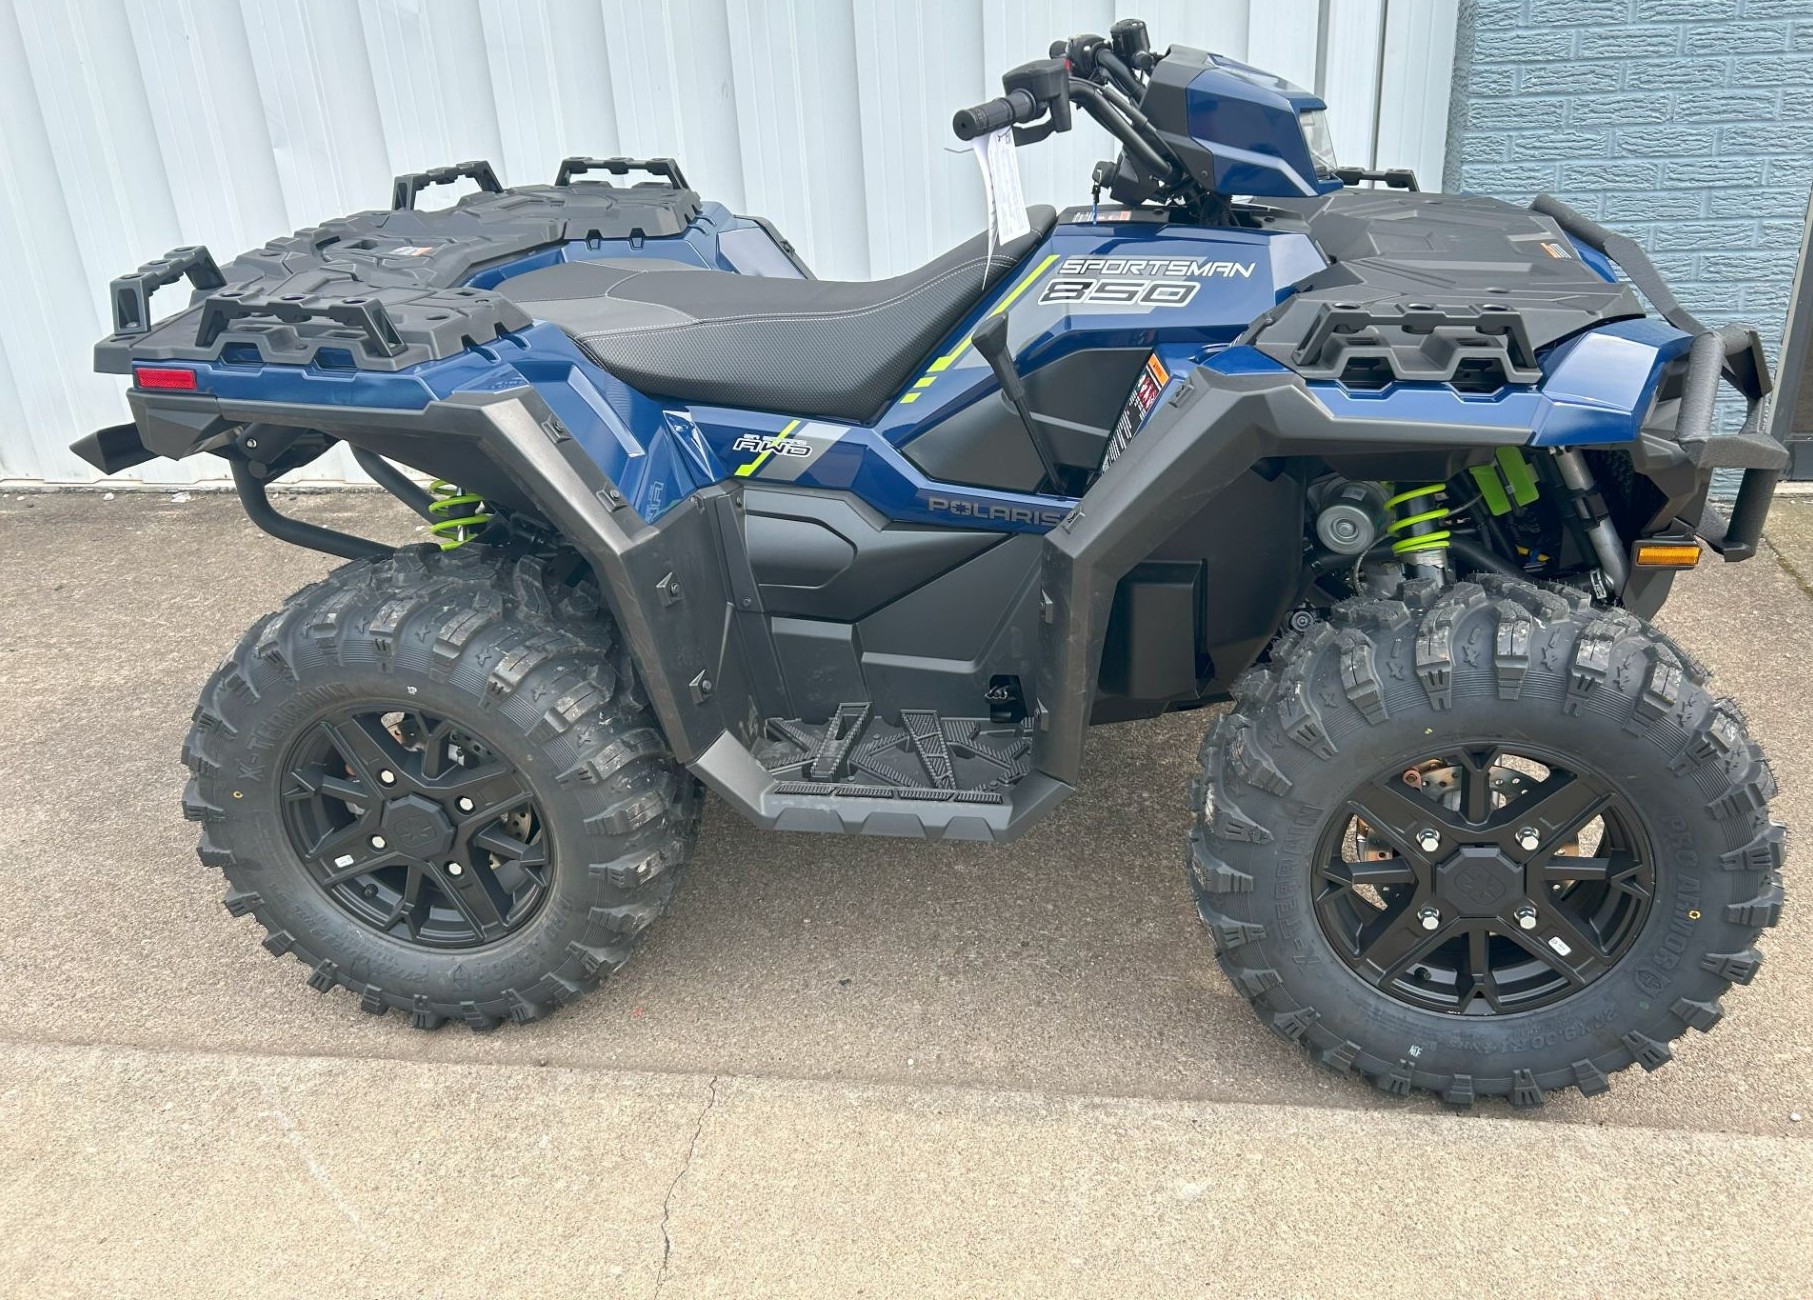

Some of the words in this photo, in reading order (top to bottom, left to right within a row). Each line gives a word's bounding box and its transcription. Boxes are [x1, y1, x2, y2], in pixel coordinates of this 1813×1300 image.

[1058, 258, 1256, 278] SPORTSMAN
[1037, 278, 1201, 307] 850
[732, 437, 812, 457] AWD
[928, 496, 1061, 527] POLARIS
[1659, 814, 1699, 868] PRO
[1275, 803, 1325, 972] X-TERRAIN
[1652, 873, 1700, 970] ARMOR
